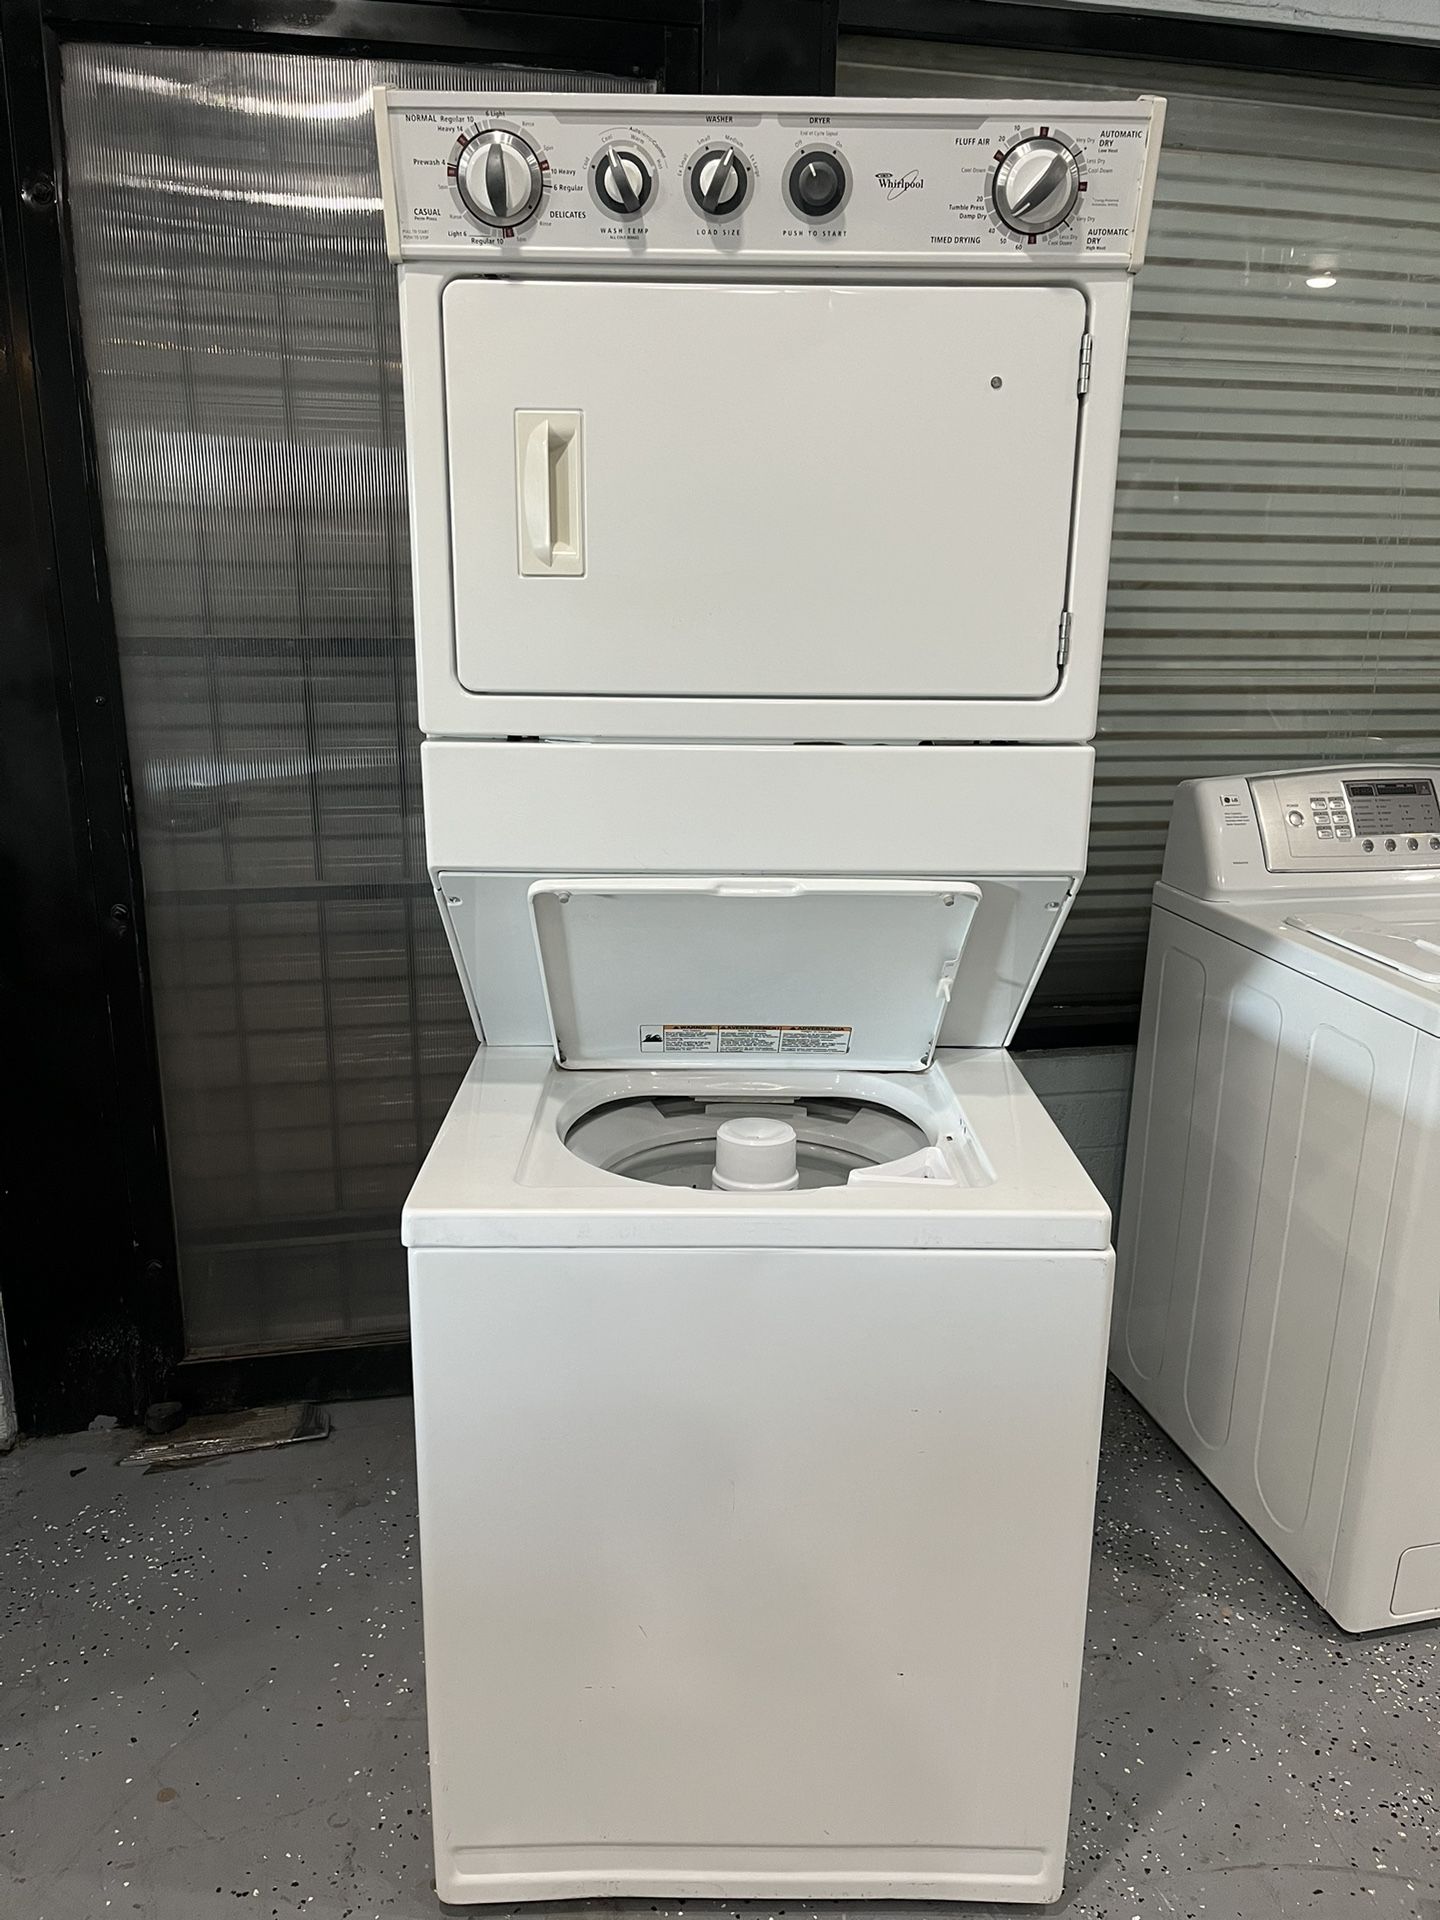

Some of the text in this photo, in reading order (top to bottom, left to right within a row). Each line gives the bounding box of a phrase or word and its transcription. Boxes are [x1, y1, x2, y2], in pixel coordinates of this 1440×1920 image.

[405, 114, 437, 122] NORMAL
[631, 134, 644, 144] Warm
[697, 135, 711, 145] Small
[413, 158, 439, 166] Prewash
[583, 156, 591, 169] Cold
[879, 178, 924, 191] Whirlpool
[414, 208, 441, 216] CASUAL
[550, 211, 586, 219] DELICATES
[931, 236, 981, 244] TIMED DRYING
